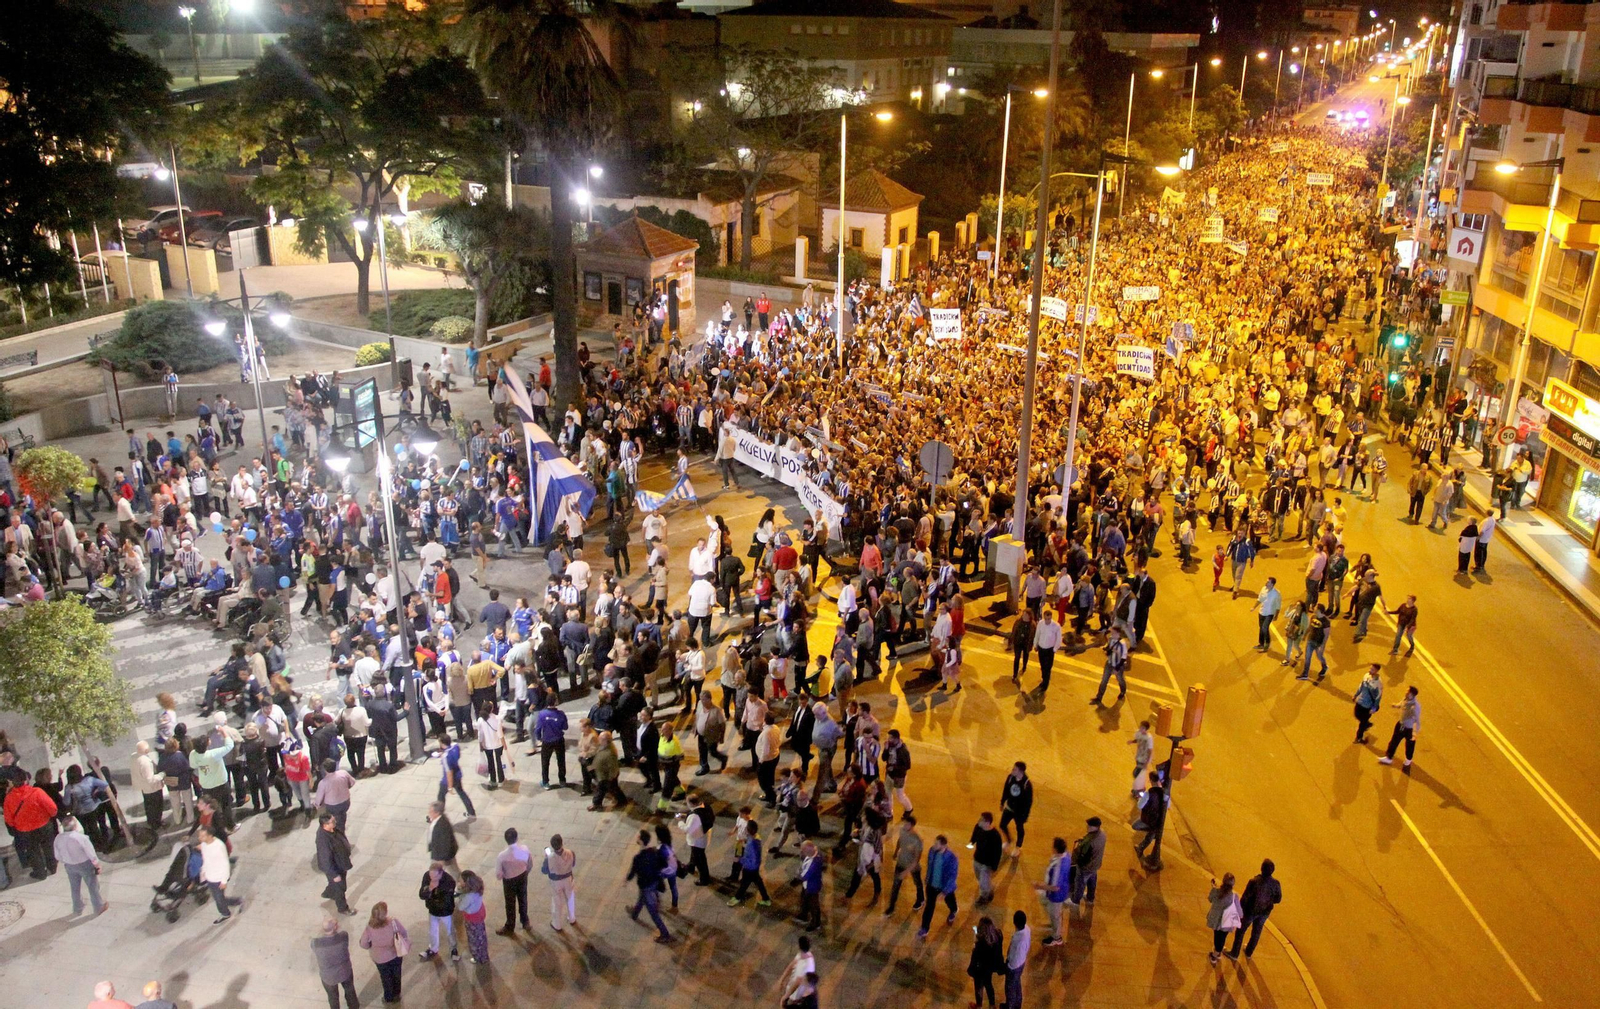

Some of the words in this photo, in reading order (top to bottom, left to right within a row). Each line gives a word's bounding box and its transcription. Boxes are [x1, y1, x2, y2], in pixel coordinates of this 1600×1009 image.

[1117, 363, 1151, 374] IDENTIDAD
[1555, 438, 1575, 455] CARNET
[1574, 449, 1582, 459] AL
[1572, 432, 1593, 450] digital
[739, 438, 779, 466] HUELVA
